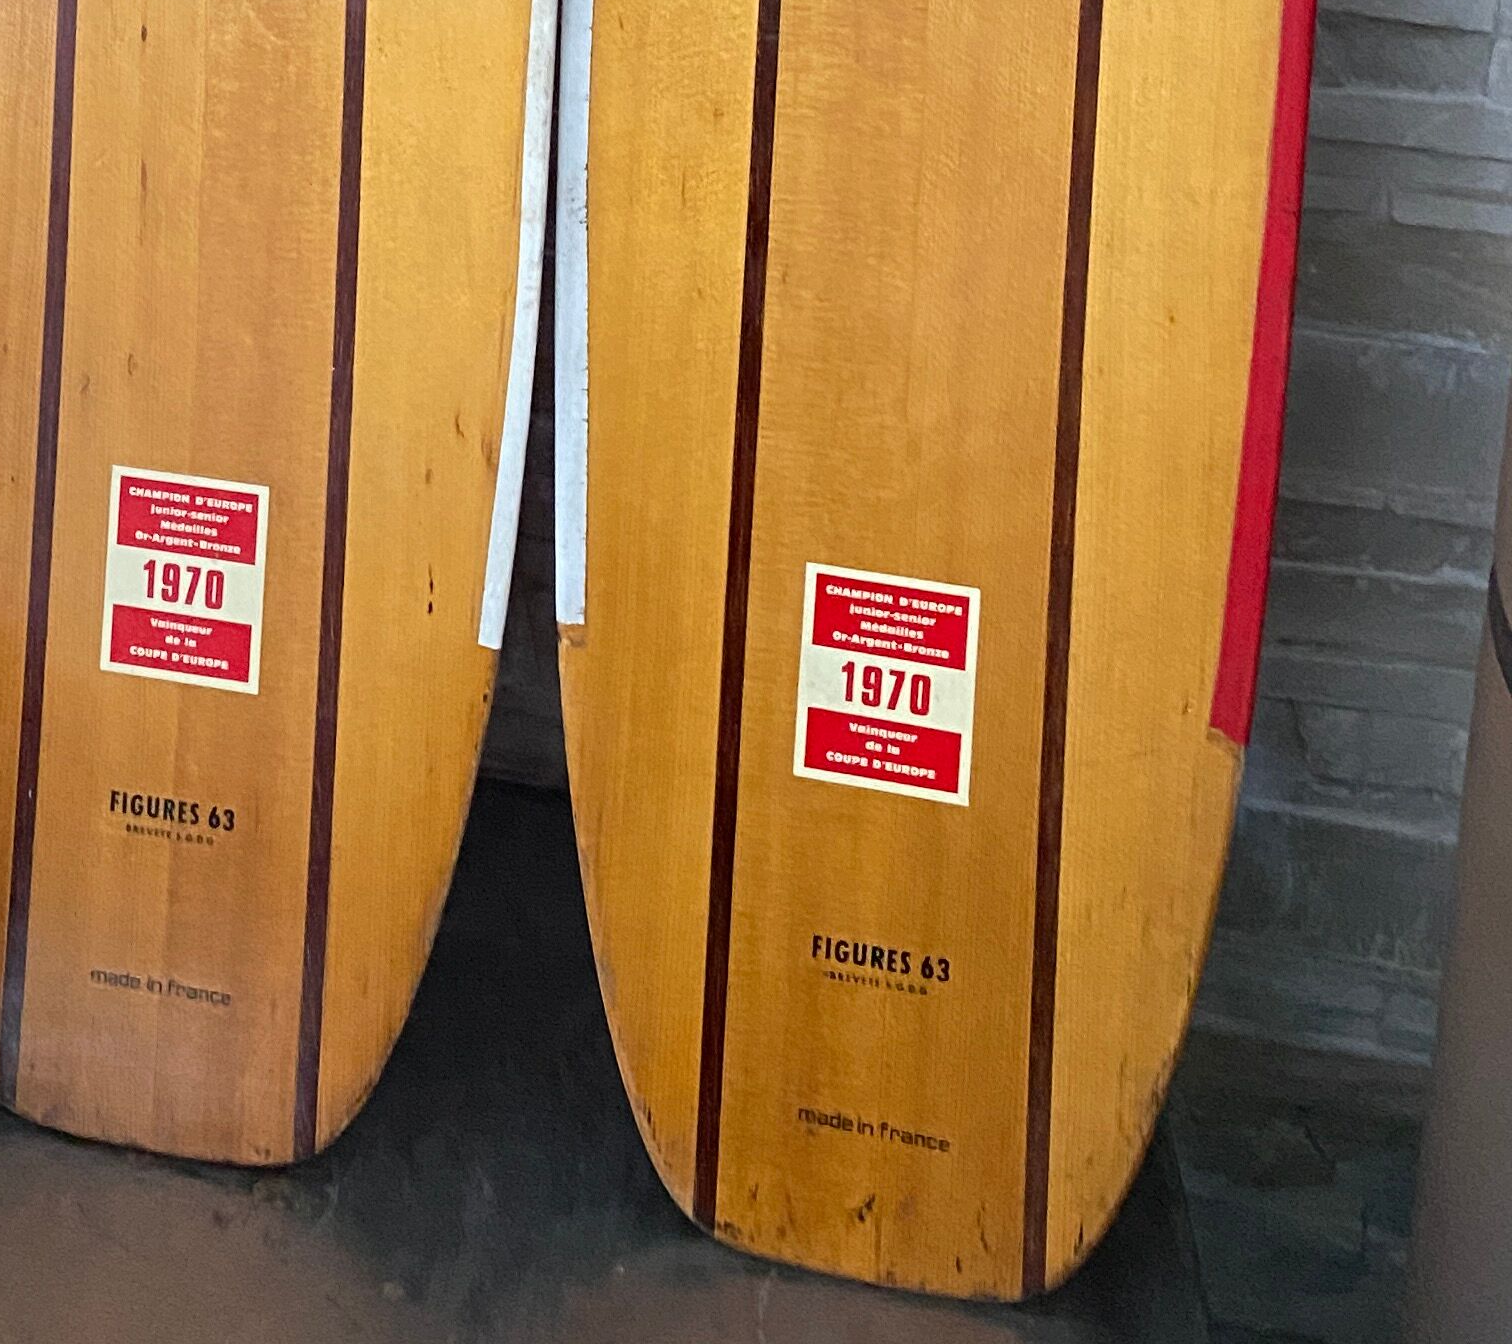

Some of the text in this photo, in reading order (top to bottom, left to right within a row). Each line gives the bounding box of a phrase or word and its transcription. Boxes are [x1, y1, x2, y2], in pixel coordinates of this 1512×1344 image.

[129, 486, 253, 513] CHAMPION D'EUROPE
[143, 560, 224, 609] 1970
[825, 584, 963, 616] CHAMPION D'EUROPE
[151, 618, 213, 636] Vainqueur
[165, 635, 181, 645] de
[129, 645, 229, 670] COUPE D'EUROPE
[841, 661, 931, 716] 1970
[849, 722, 918, 743] Vainqueur
[865, 740, 883, 752] de
[825, 751, 936, 780] COUPE D'EUROPE
[110, 790, 235, 831] FIGURES 63
[812, 935, 950, 982] FIGURES 63
[91, 969, 231, 1006] made in france
[798, 1108, 950, 1152] made in france
